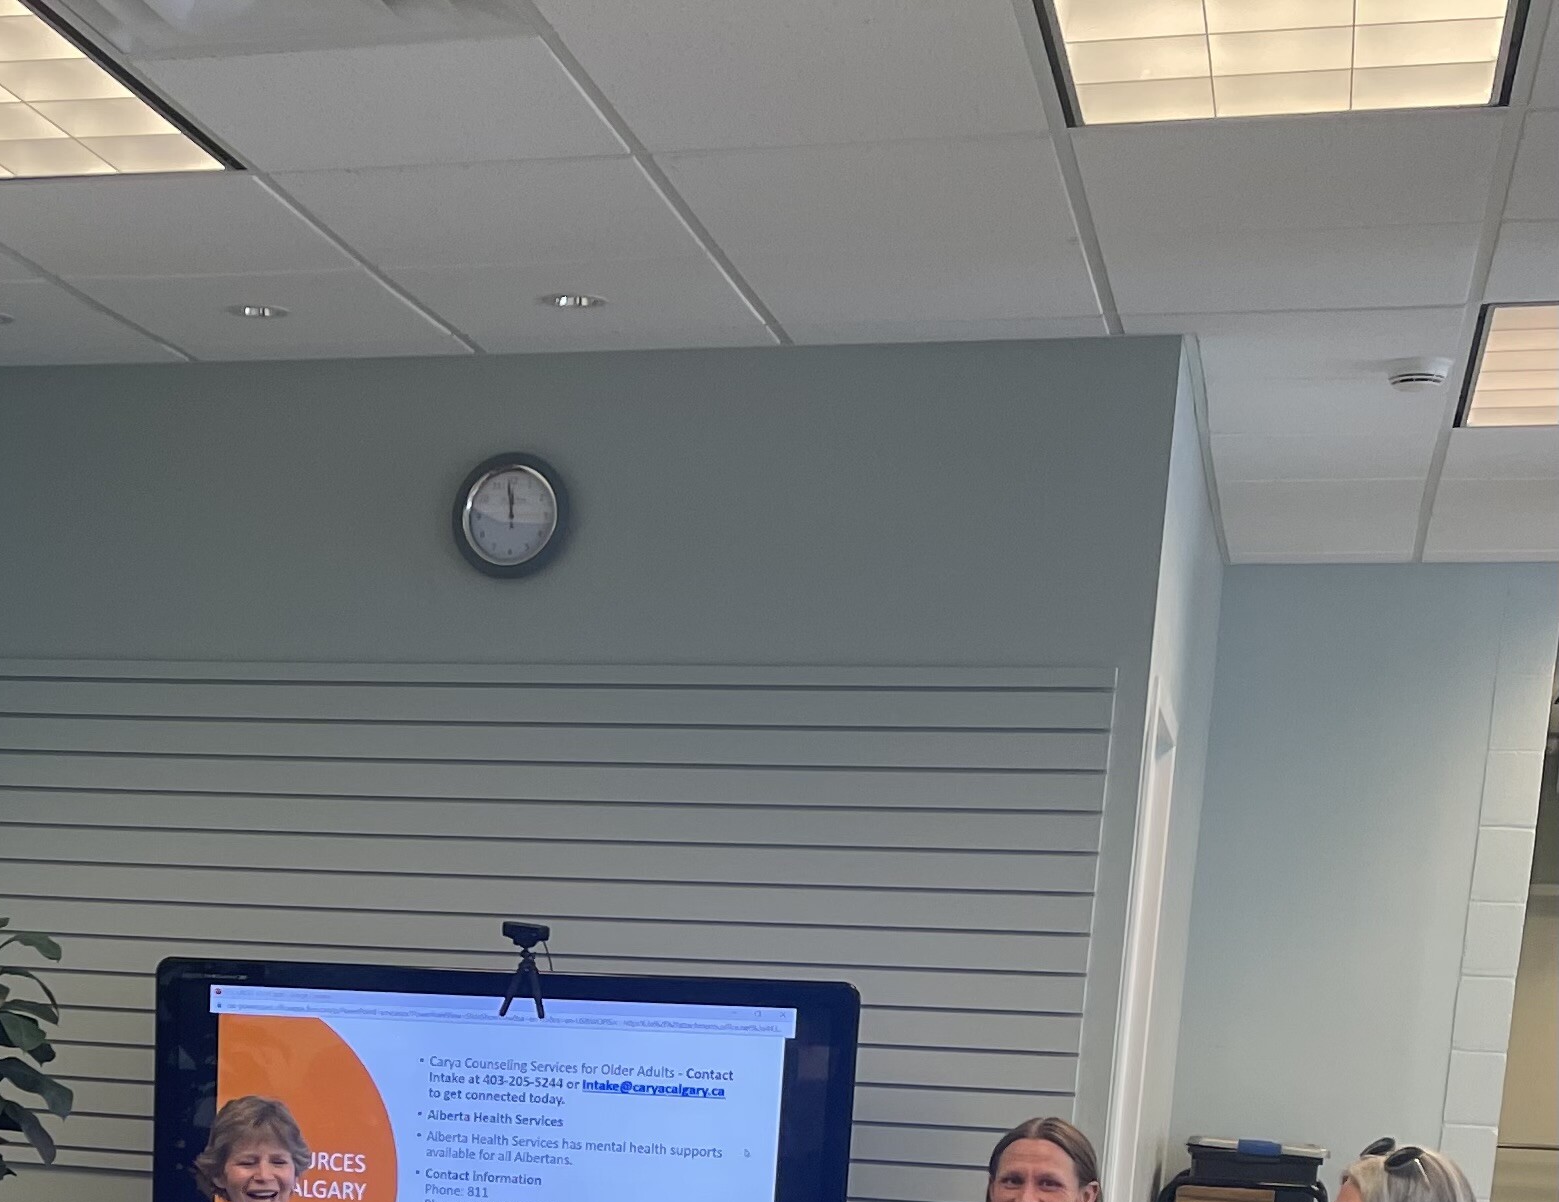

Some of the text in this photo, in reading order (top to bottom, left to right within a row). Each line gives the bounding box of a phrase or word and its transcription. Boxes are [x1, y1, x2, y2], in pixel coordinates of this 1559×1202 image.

[429, 1057, 462, 1071] Carya
[464, 1058, 528, 1074] Counseling
[530, 1061, 578, 1074] Services
[581, 1063, 599, 1075] for
[636, 1066, 675, 1078] Adults
[685, 1068, 734, 1081] Contact
[429, 1072, 465, 1085] Intake
[468, 1074, 480, 1086] at
[482, 1074, 563, 1089] 403-205-5244
[566, 1081, 580, 1090] or
[428, 1088, 566, 1108] to get connected today.
[427, 1110, 564, 1127] Alberta Health Services
[426, 1131, 723, 1159] Alberta Health Services has mental health supports
[426, 1147, 573, 1165] available for all Albertans.
[425, 1168, 542, 1186] Contact Information
[291, 1179, 367, 1201] ALGARY
[425, 1184, 489, 1198] Phone: 811
